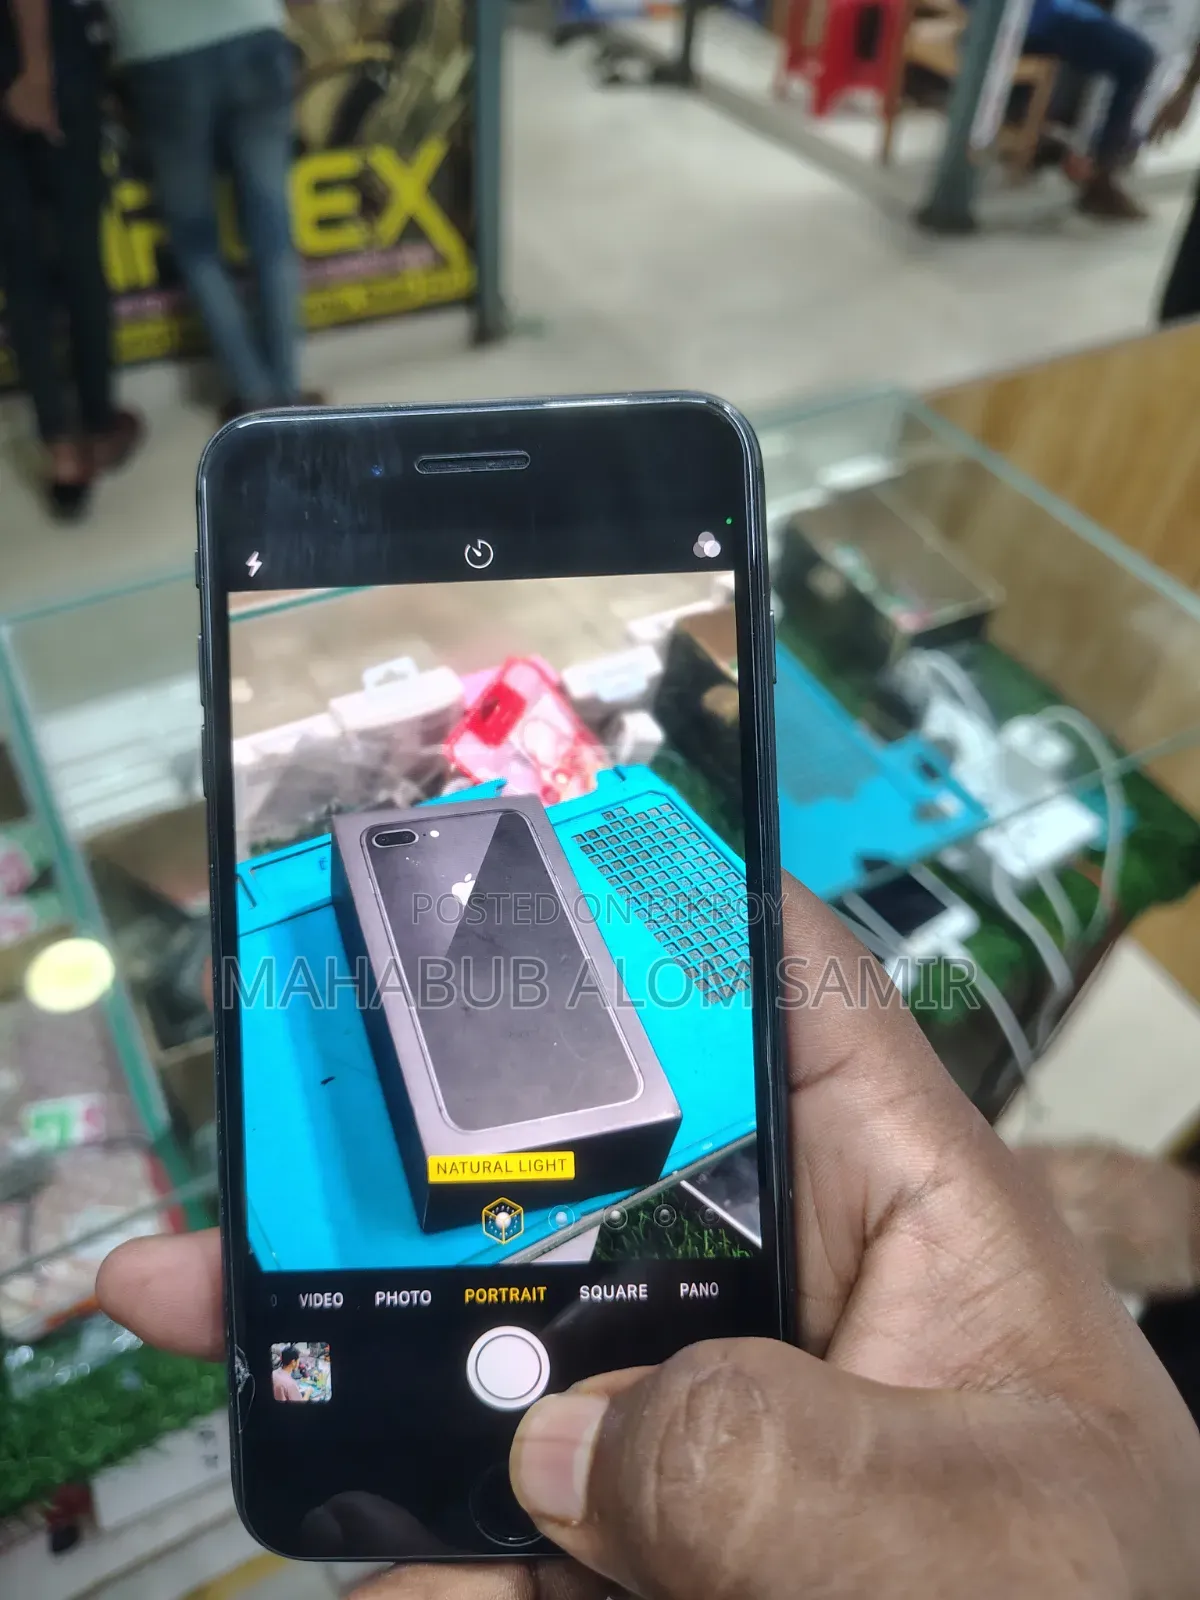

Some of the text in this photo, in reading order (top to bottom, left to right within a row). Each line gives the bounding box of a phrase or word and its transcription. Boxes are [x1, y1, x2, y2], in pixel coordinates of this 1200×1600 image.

[436, 1158, 568, 1175] NATURAL LIGHT
[299, 1291, 345, 1309] VIDEO
[374, 1289, 433, 1308] PHOTO
[464, 1286, 548, 1305] PORTRAIT
[579, 1283, 649, 1302] SQUARE
[679, 1281, 720, 1300] PANO
